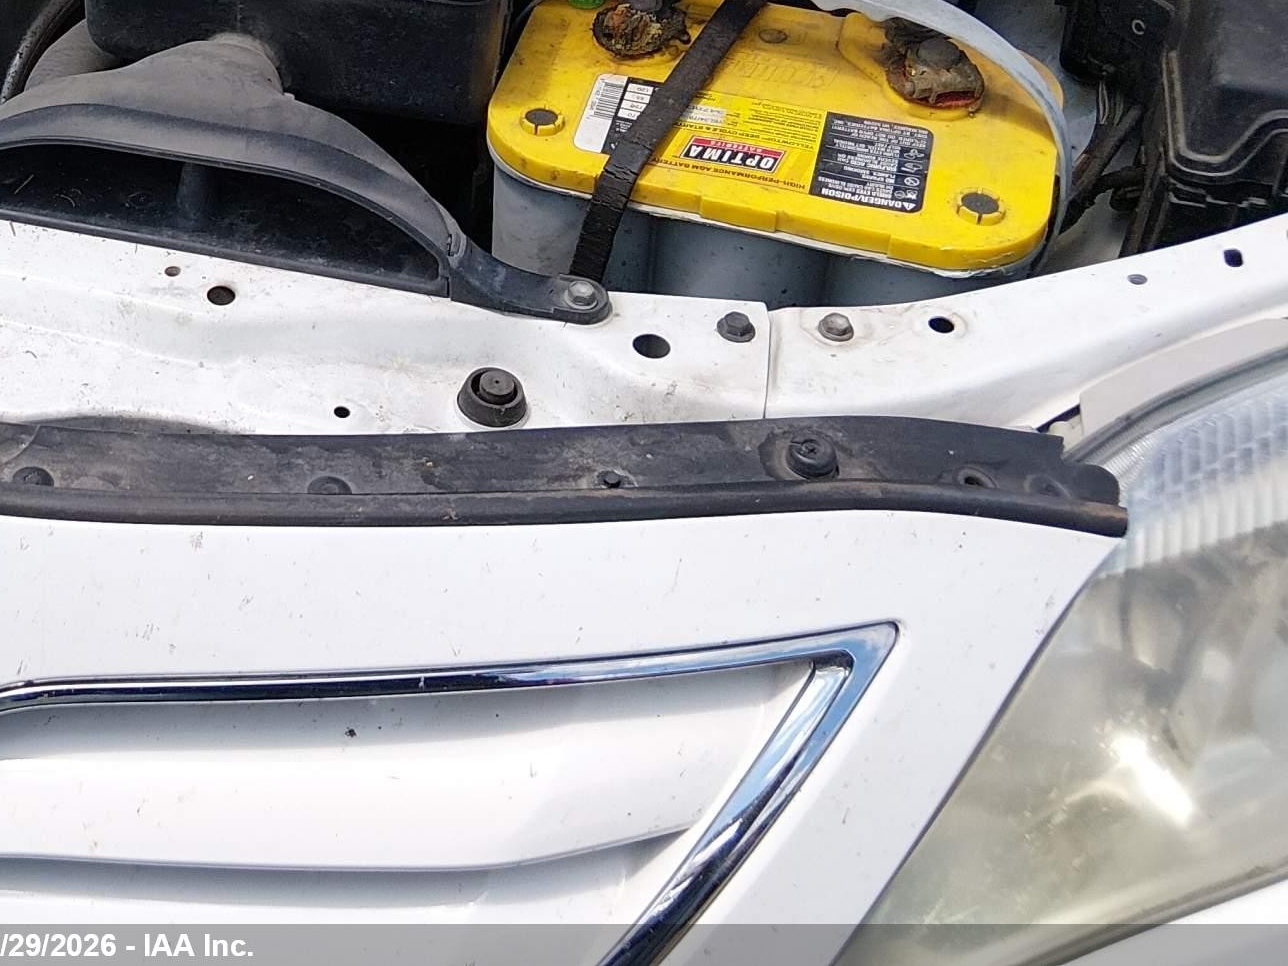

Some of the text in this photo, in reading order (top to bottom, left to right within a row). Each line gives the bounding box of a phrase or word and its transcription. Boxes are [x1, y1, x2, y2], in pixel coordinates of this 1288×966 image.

[689, 145, 775, 169] OPTIMA
[711, 140, 763, 153] BATTERIES
[691, 164, 712, 173] AGM
[714, 167, 805, 189] HIGH-PERFORMANCE
[820, 187, 902, 208] DANGER/POISON
